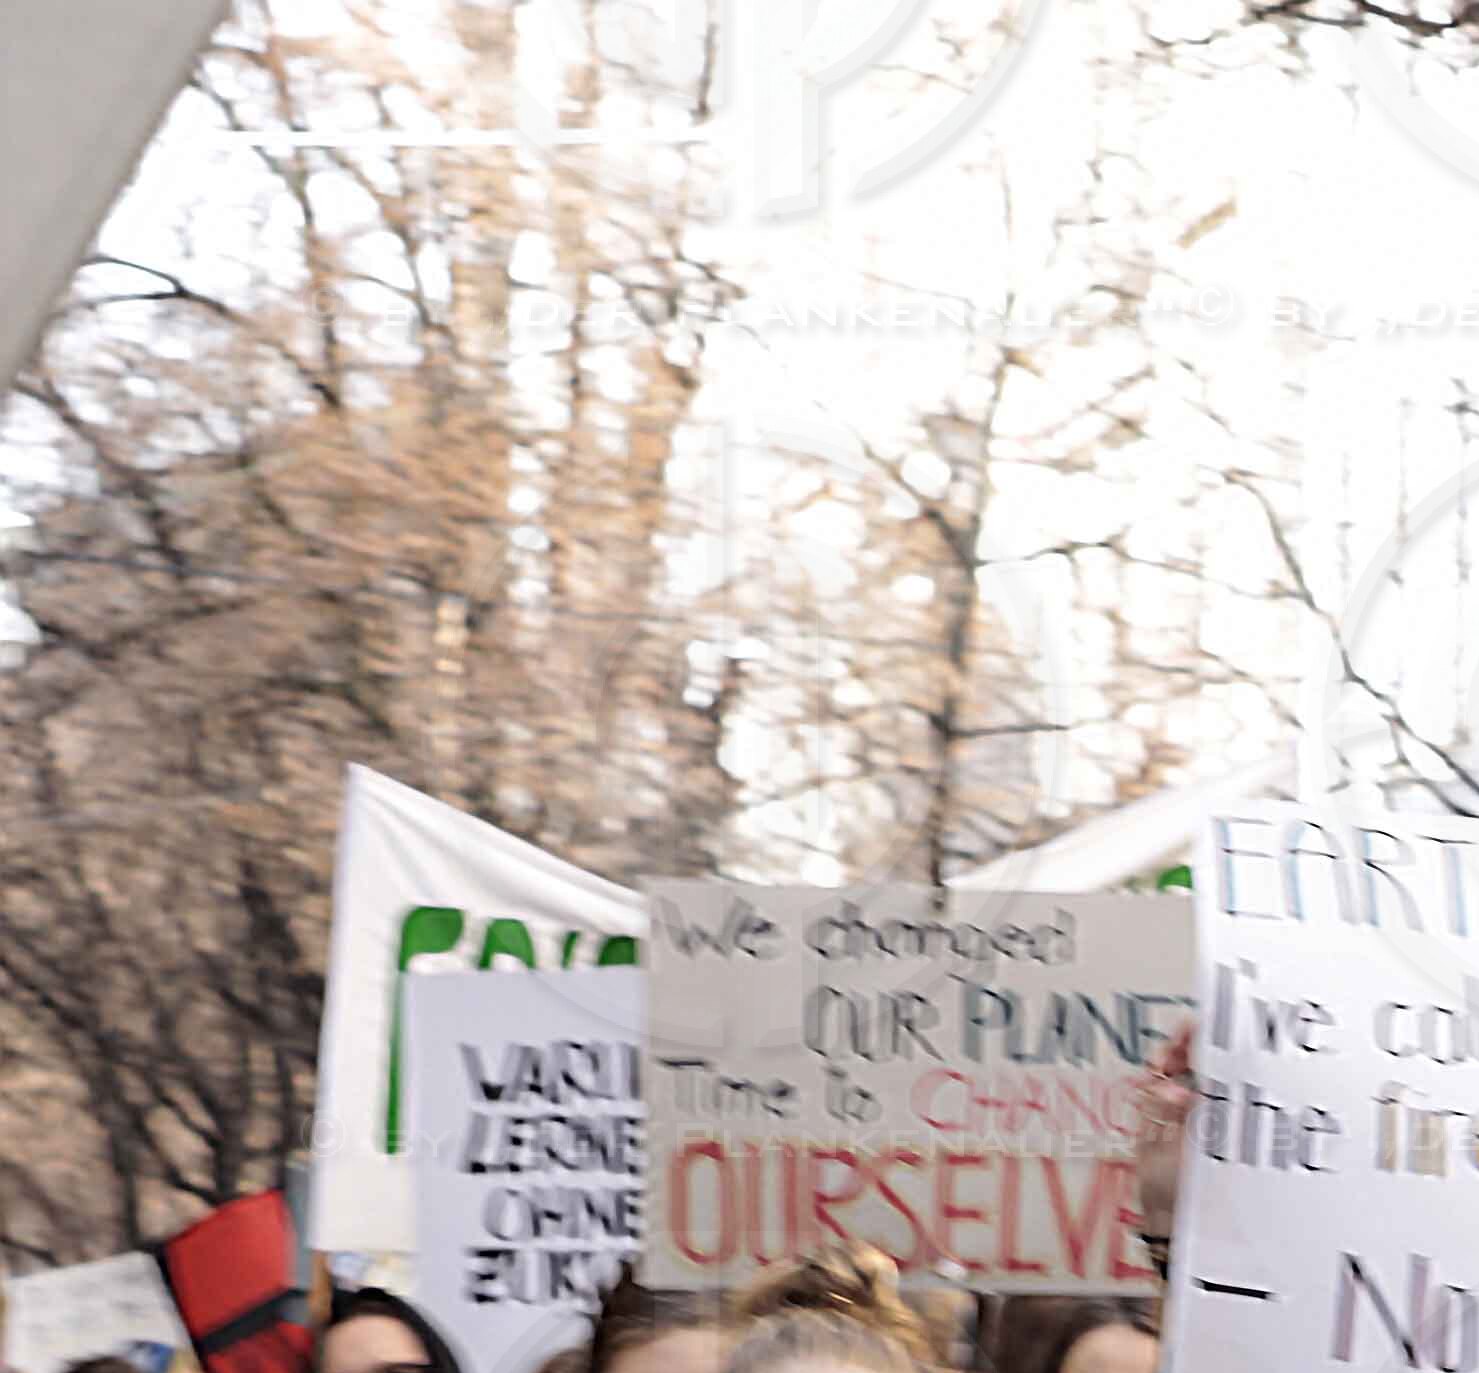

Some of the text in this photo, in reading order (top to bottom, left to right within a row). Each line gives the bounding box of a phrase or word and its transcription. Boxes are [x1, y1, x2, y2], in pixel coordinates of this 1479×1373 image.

[655, 896, 1075, 972] We changed
[803, 984, 946, 1064] OUR
[1198, 1078, 1342, 1176] the
[667, 1132, 1160, 1285] OURSELVE
